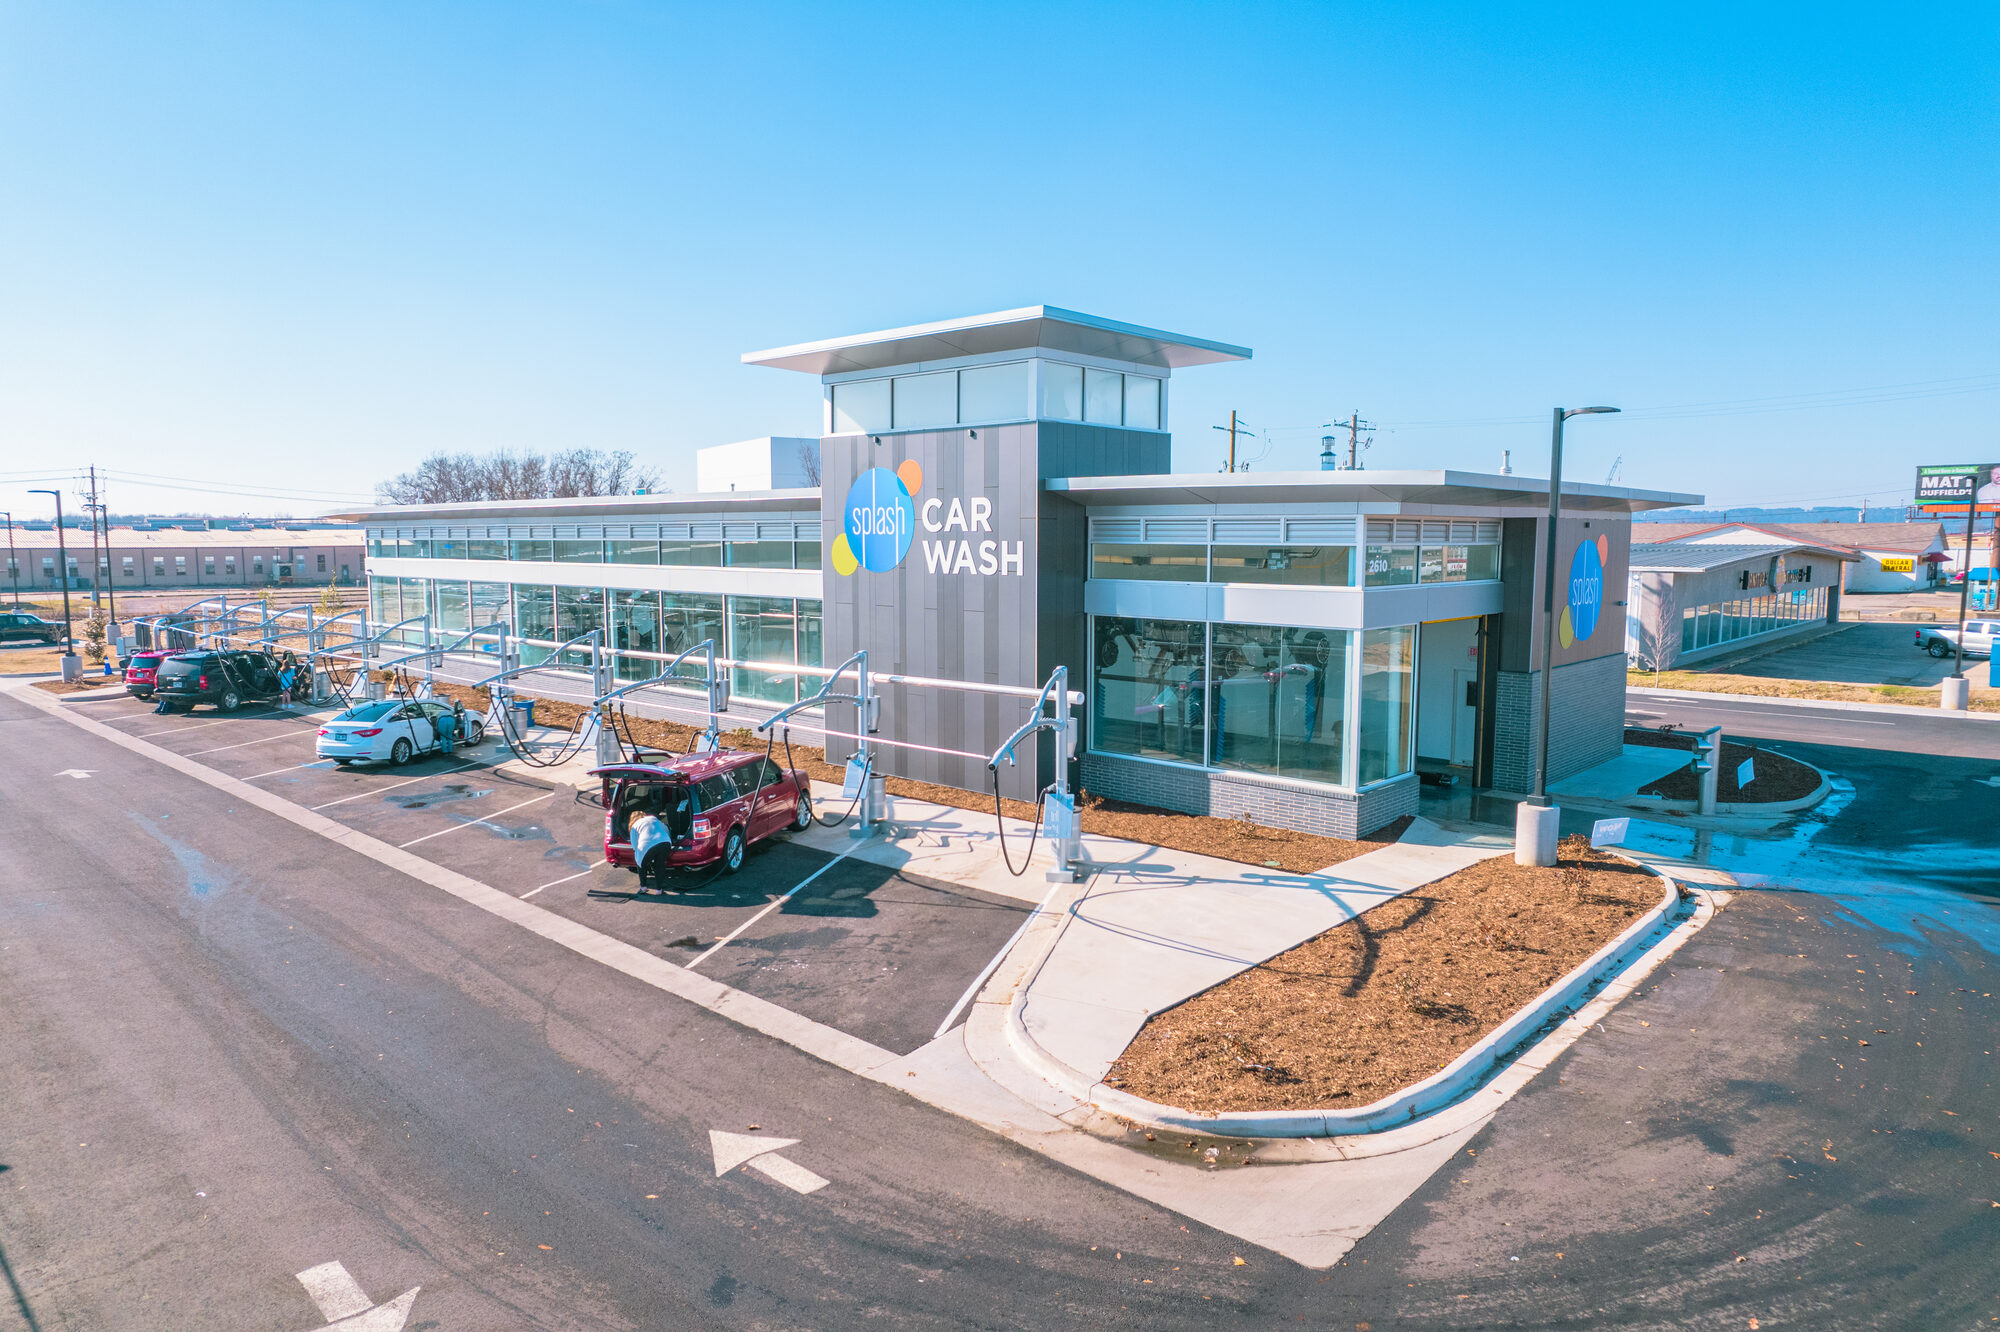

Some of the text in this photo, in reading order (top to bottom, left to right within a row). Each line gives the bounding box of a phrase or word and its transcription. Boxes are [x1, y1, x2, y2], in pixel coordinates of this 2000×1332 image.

[852, 468, 905, 568] splash
[921, 497, 992, 533] CAR
[921, 540, 1024, 576] WASH
[1368, 559, 1388, 573] 2610
